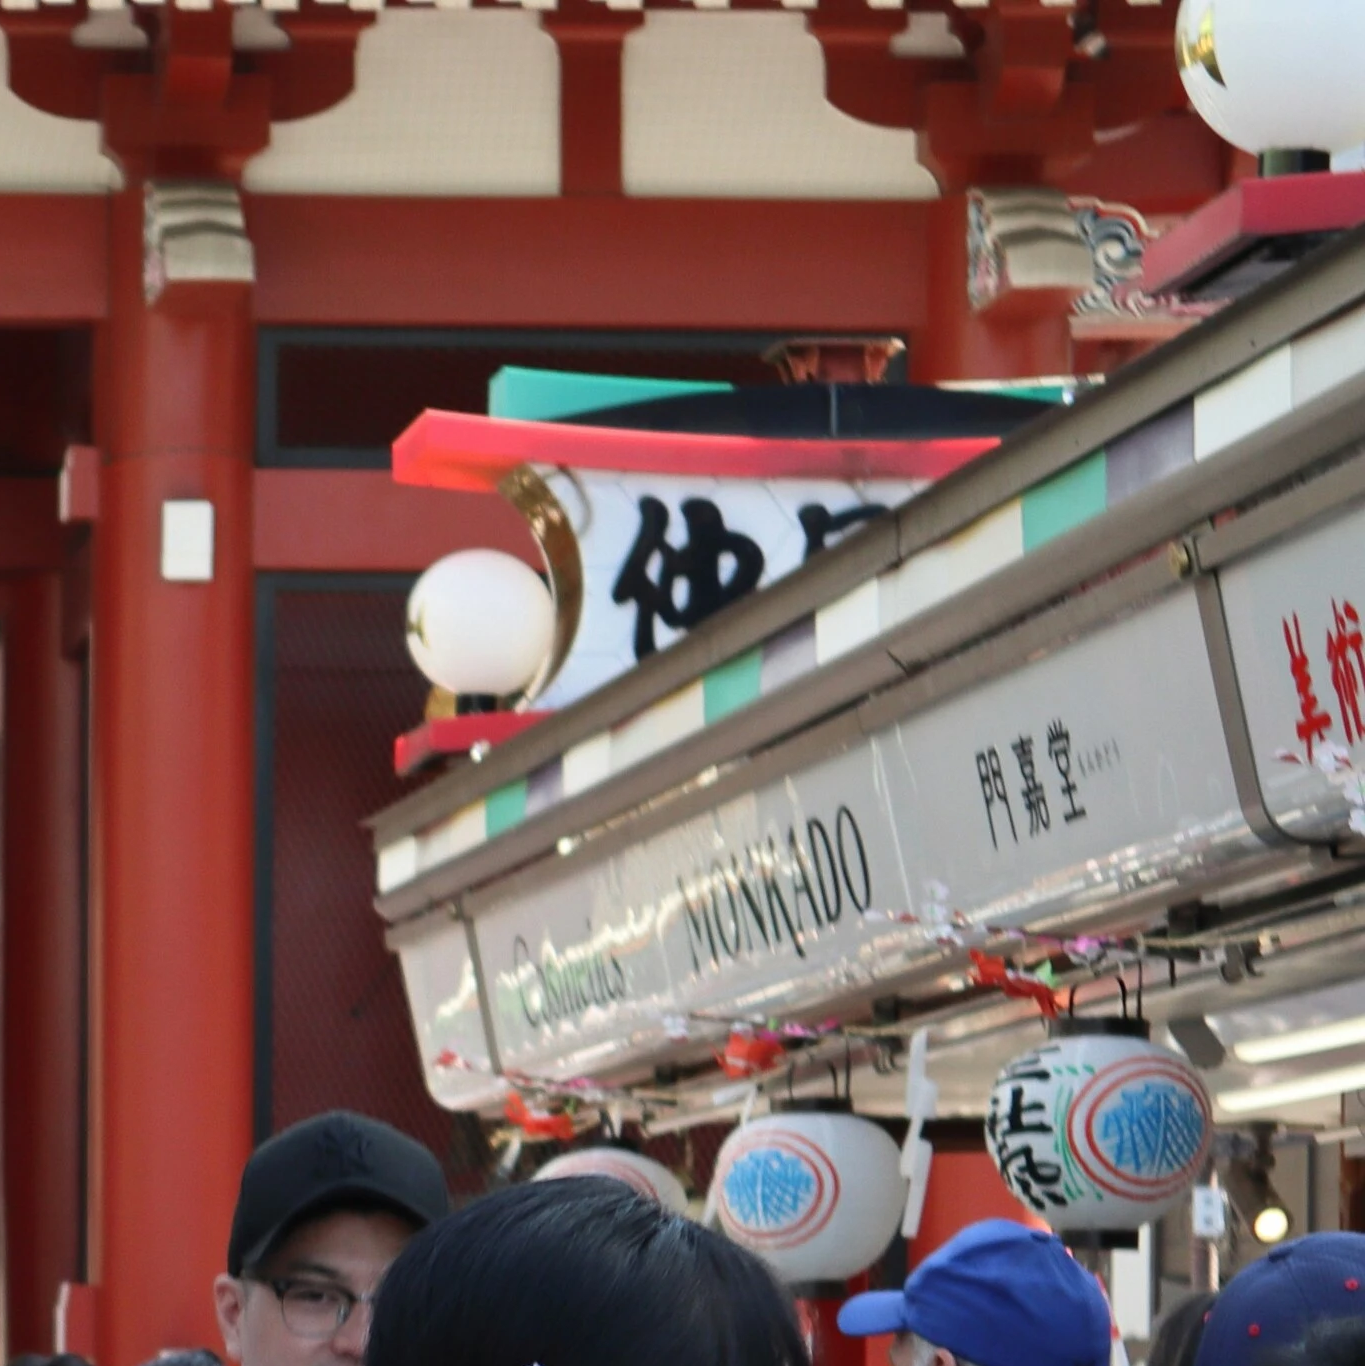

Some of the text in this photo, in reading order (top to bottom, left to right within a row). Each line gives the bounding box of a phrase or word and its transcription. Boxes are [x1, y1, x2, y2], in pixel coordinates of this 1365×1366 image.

[975, 717, 1087, 852] 門嘉堂
[677, 804, 871, 973] MONKADO
